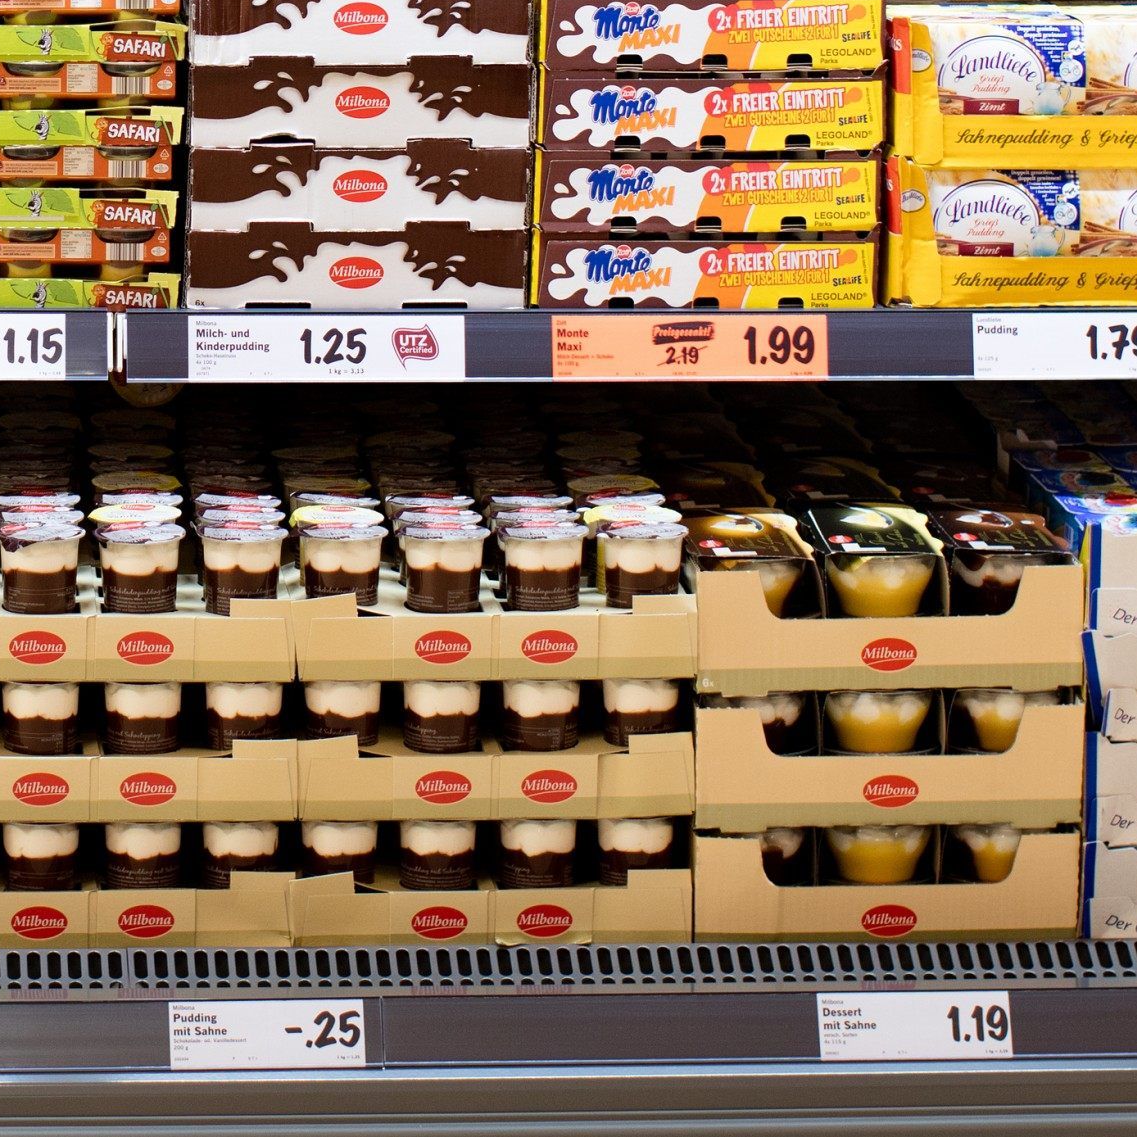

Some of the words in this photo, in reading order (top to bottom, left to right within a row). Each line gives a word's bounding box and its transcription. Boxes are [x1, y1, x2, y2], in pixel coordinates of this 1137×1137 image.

[335, 11, 387, 25] Milbona
[592, 6, 663, 41] Monte
[716, 11, 731, 31] 2x
[736, 8, 783, 28] FREIER
[788, 5, 849, 26] EINTRITT
[618, 22, 681, 53] MAXI
[113, 37, 166, 58] SAFARI
[953, 51, 1037, 83] Landliebe
[971, 84, 1010, 94] Pudding
[336, 95, 388, 109] Milbona
[979, 103, 1005, 111] Zimt
[107, 122, 160, 142] SAFARI
[955, 129, 1073, 148] Sahnepudding
[1081, 131, 1089, 146] &
[195, 299, 205, 307] 6x
[196, 328, 227, 338] Milch-
[231, 329, 250, 338] und
[557, 329, 589, 338] Monte
[978, 326, 1018, 336] Pudding
[4, 328, 63, 364] 1.15
[196, 341, 270, 352] Kinderpudding
[300, 328, 367, 364] 1.25
[400, 334, 427, 346] UTZ
[557, 342, 582, 351] Maxi
[744, 326, 814, 364] 1.99
[400, 345, 433, 354] Certified
[665, 346, 700, 364] 2.19
[10, 641, 65, 656] Milbona
[416, 640, 469, 653] Milbona
[863, 648, 915, 660] Milbona
[702, 678, 714, 689] 6x
[1113, 707, 1136, 725] Der
[121, 782, 175, 796] Milbona
[522, 779, 575, 791] Milbona
[864, 784, 917, 796] Milbona
[174, 1013, 217, 1024] Pudding
[823, 1008, 862, 1016] Dessert
[285, 1010, 361, 1048] -.25
[823, 1021, 841, 1030] mit
[845, 1021, 877, 1030] Sahne
[947, 1005, 1008, 1042] 1.19
[174, 1027, 191, 1036] mit
[194, 1027, 227, 1036] Sahne
